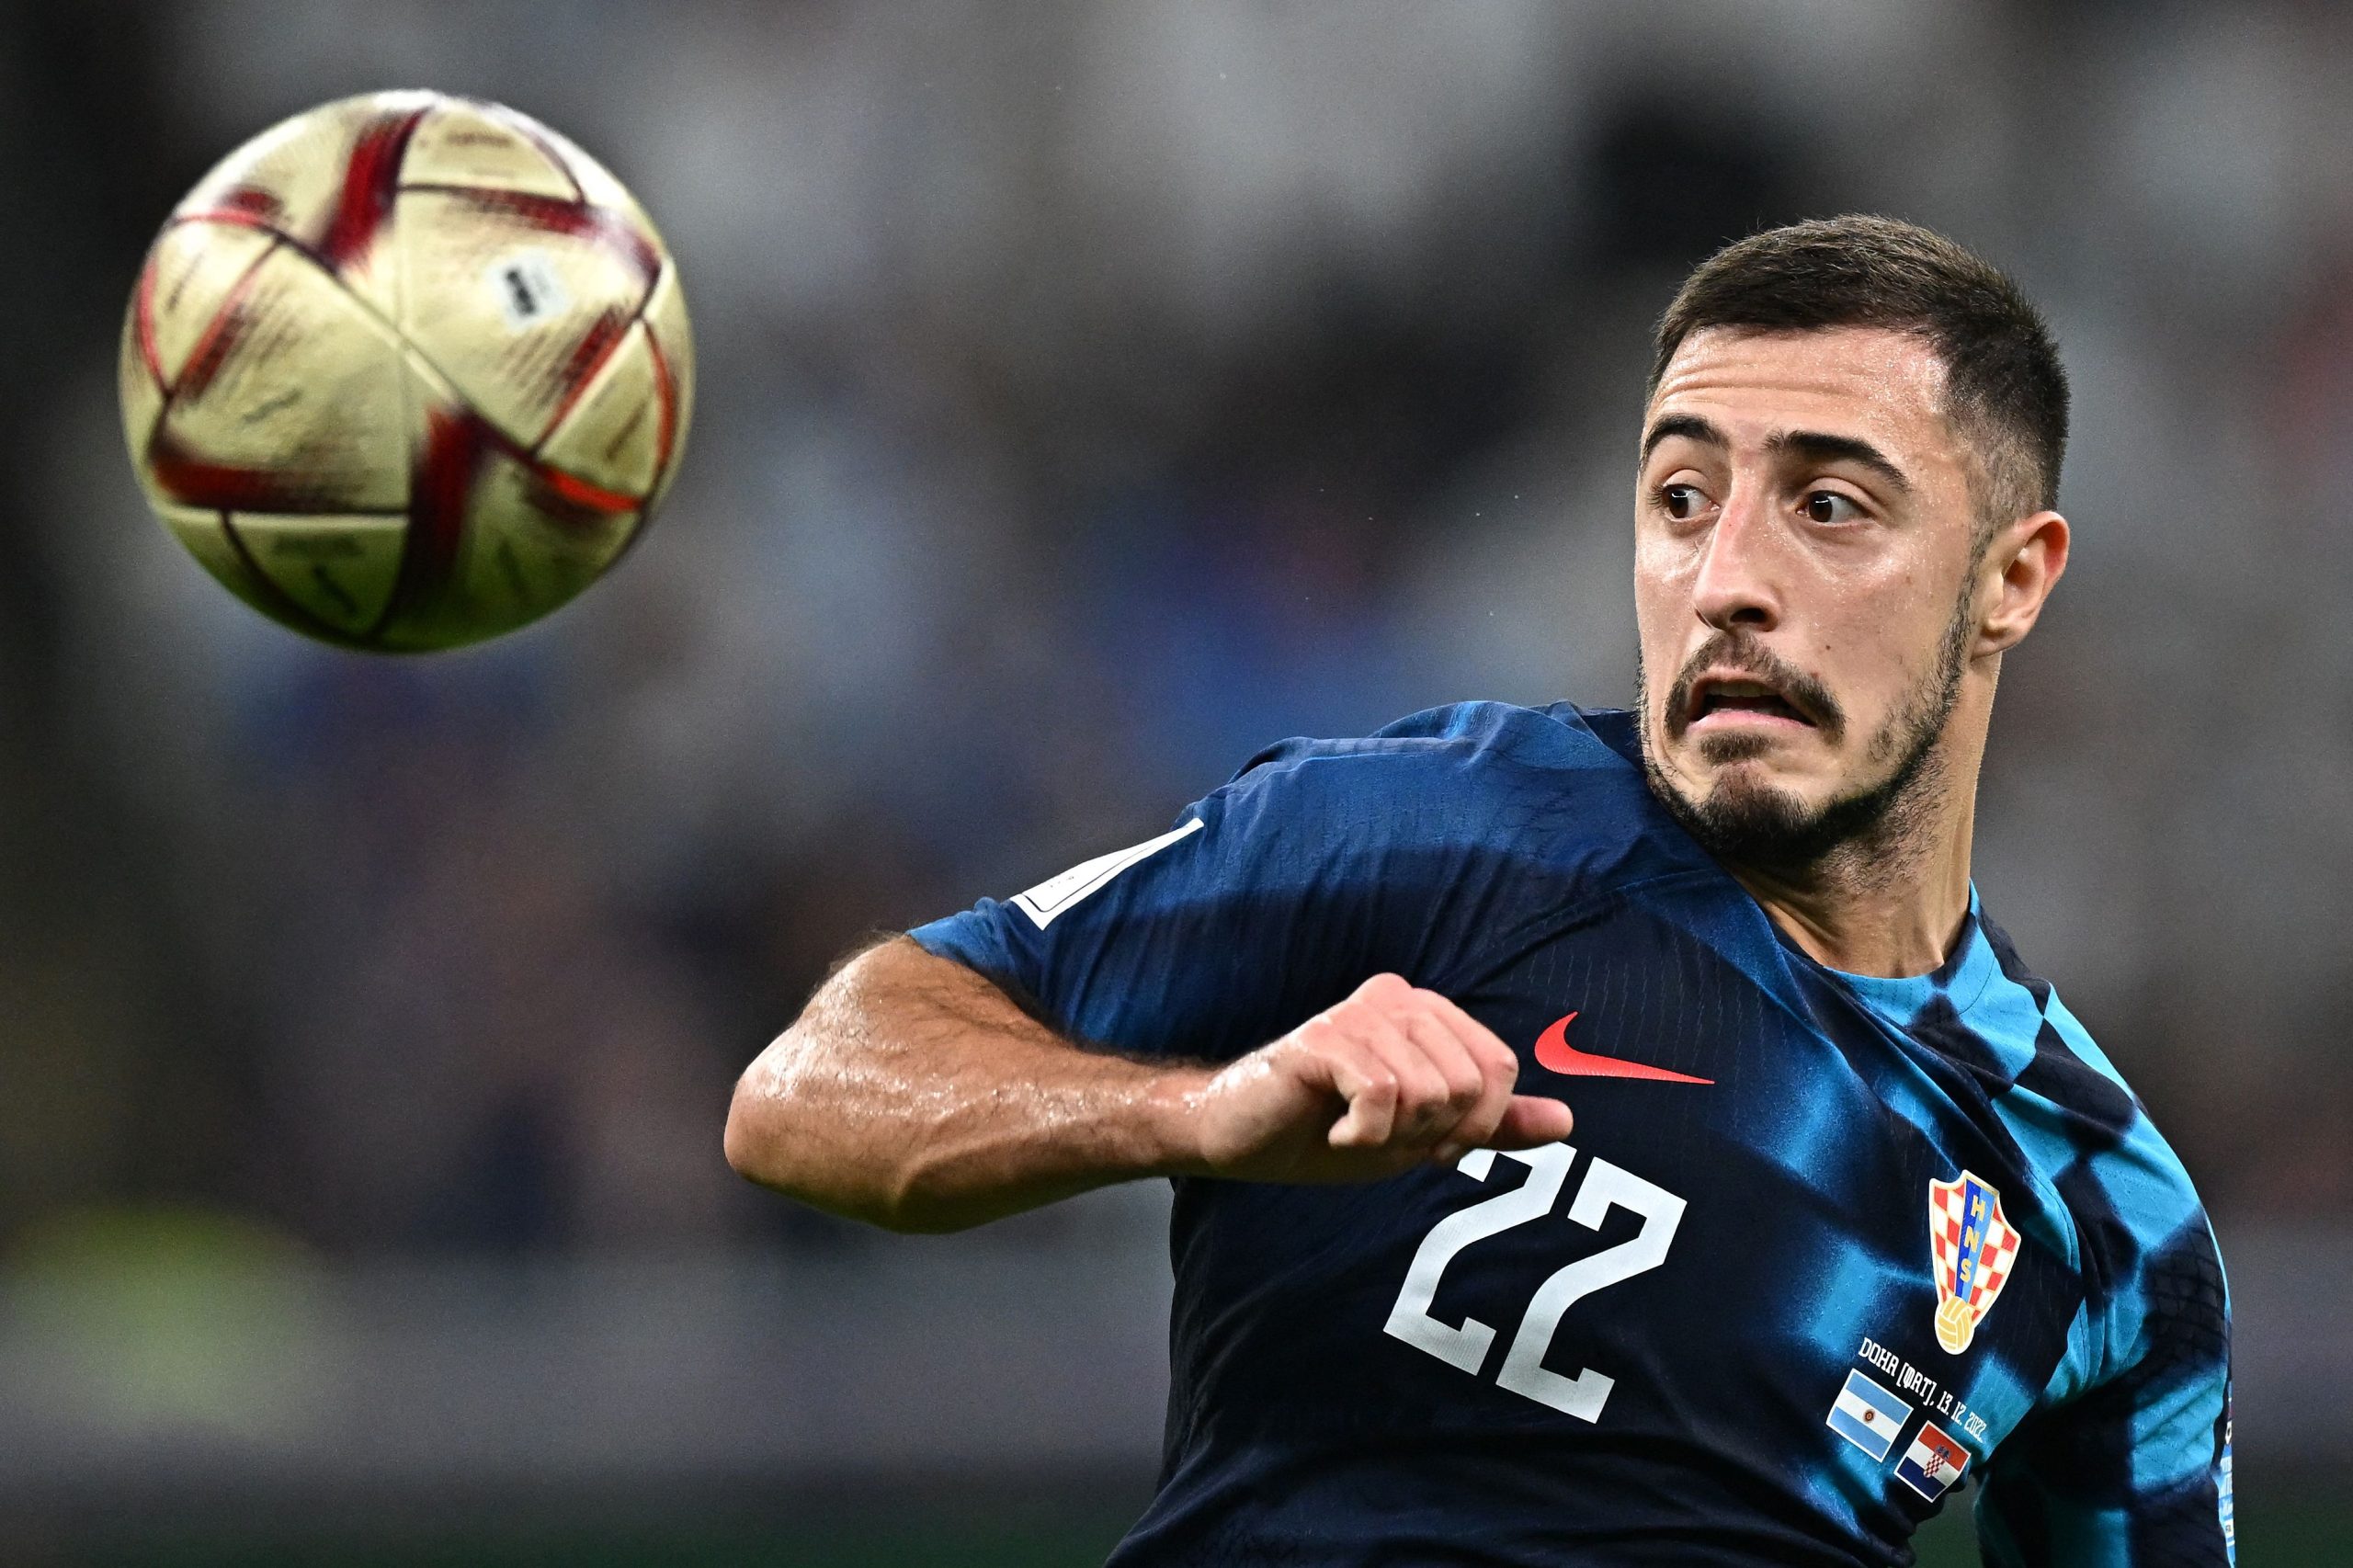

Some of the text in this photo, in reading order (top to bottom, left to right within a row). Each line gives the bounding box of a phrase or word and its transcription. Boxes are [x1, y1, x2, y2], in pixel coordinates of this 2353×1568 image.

[1383, 1141, 1688, 1425] 22
[1960, 1194, 1986, 1283] HNS
[1858, 1336, 1900, 1377] DOHA
